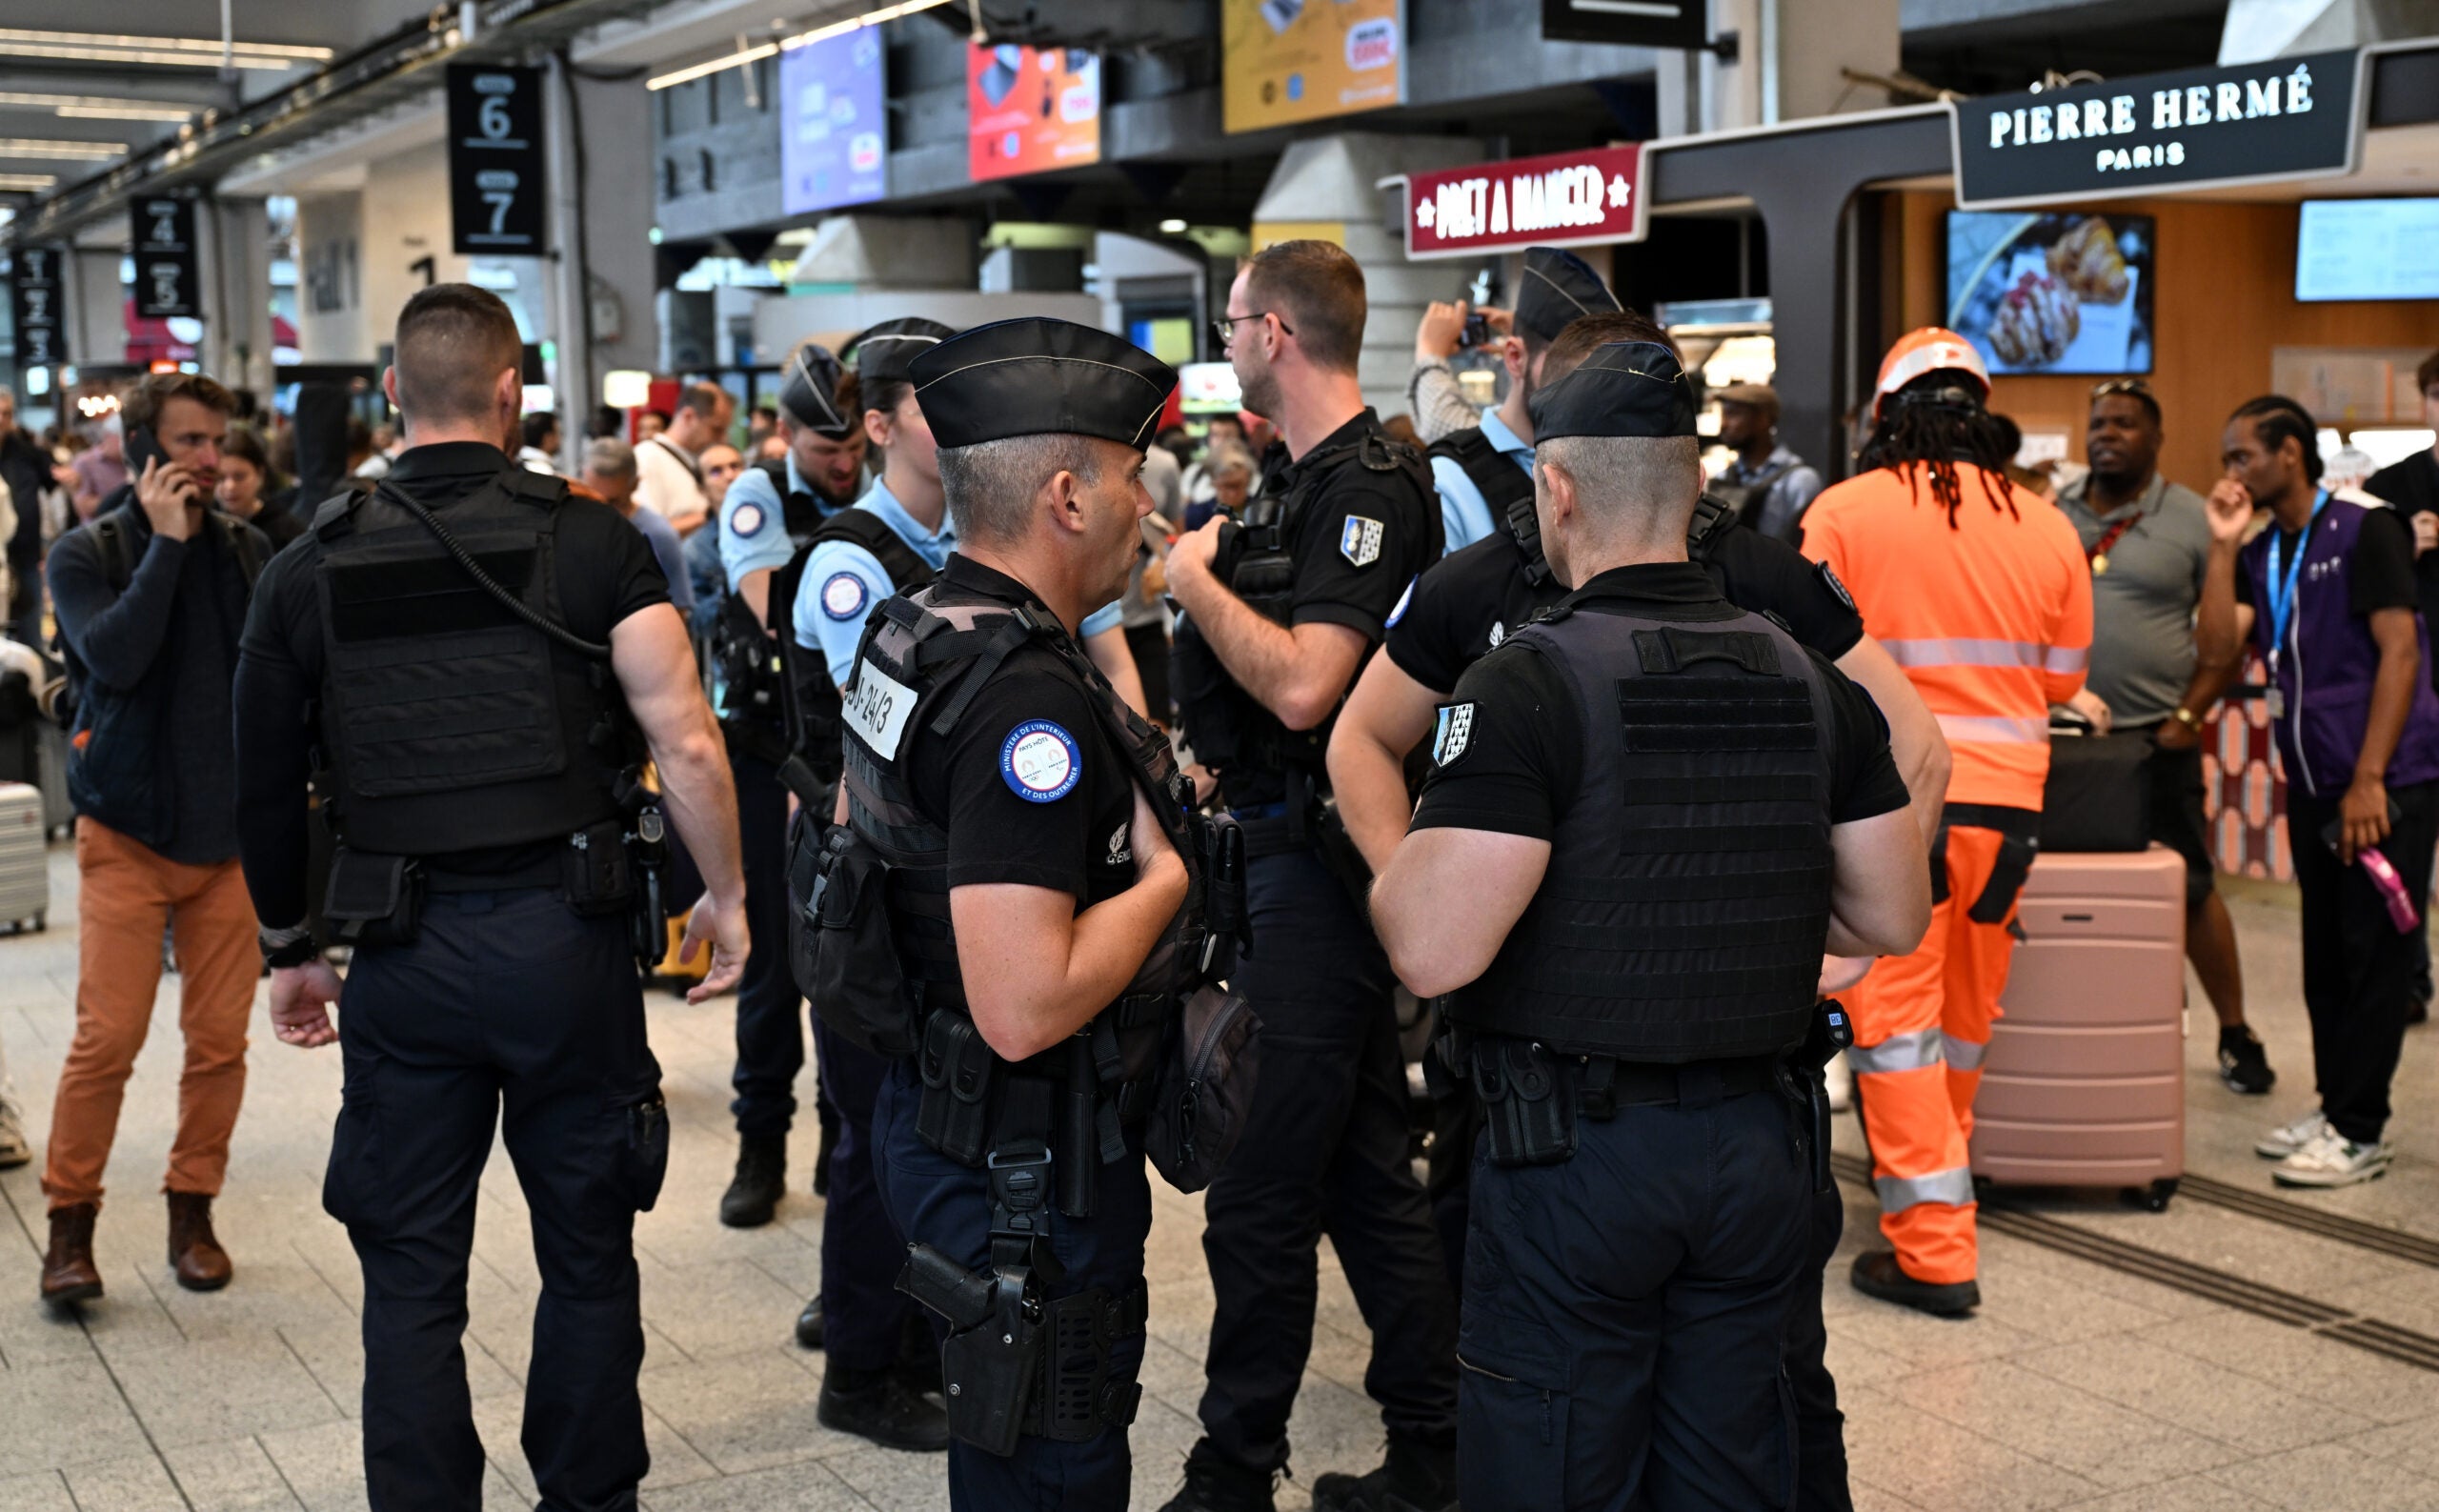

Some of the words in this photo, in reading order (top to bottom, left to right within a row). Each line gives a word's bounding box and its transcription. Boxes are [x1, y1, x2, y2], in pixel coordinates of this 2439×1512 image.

[479, 96, 512, 140] 6
[1989, 94, 2136, 149] PIERRE
[2151, 63, 2313, 130] HERMÉ
[2096, 142, 2186, 172] PARIS
[481, 192, 514, 235] 7
[1436, 177, 1489, 239] PRET
[1490, 179, 1509, 234] A
[1512, 165, 1605, 232] MANGER
[151, 213, 175, 246] 4
[1003, 733, 1020, 772] MINISTERE
[1019, 726, 1030, 735] DE
[1031, 723, 1072, 747] L'INTERIEUR
[1018, 741, 1033, 753] PAYS
[1033, 736, 1049, 747] HÔTE
[1021, 787, 1032, 796] ET
[1048, 766, 1078, 798] OUTRE-MER
